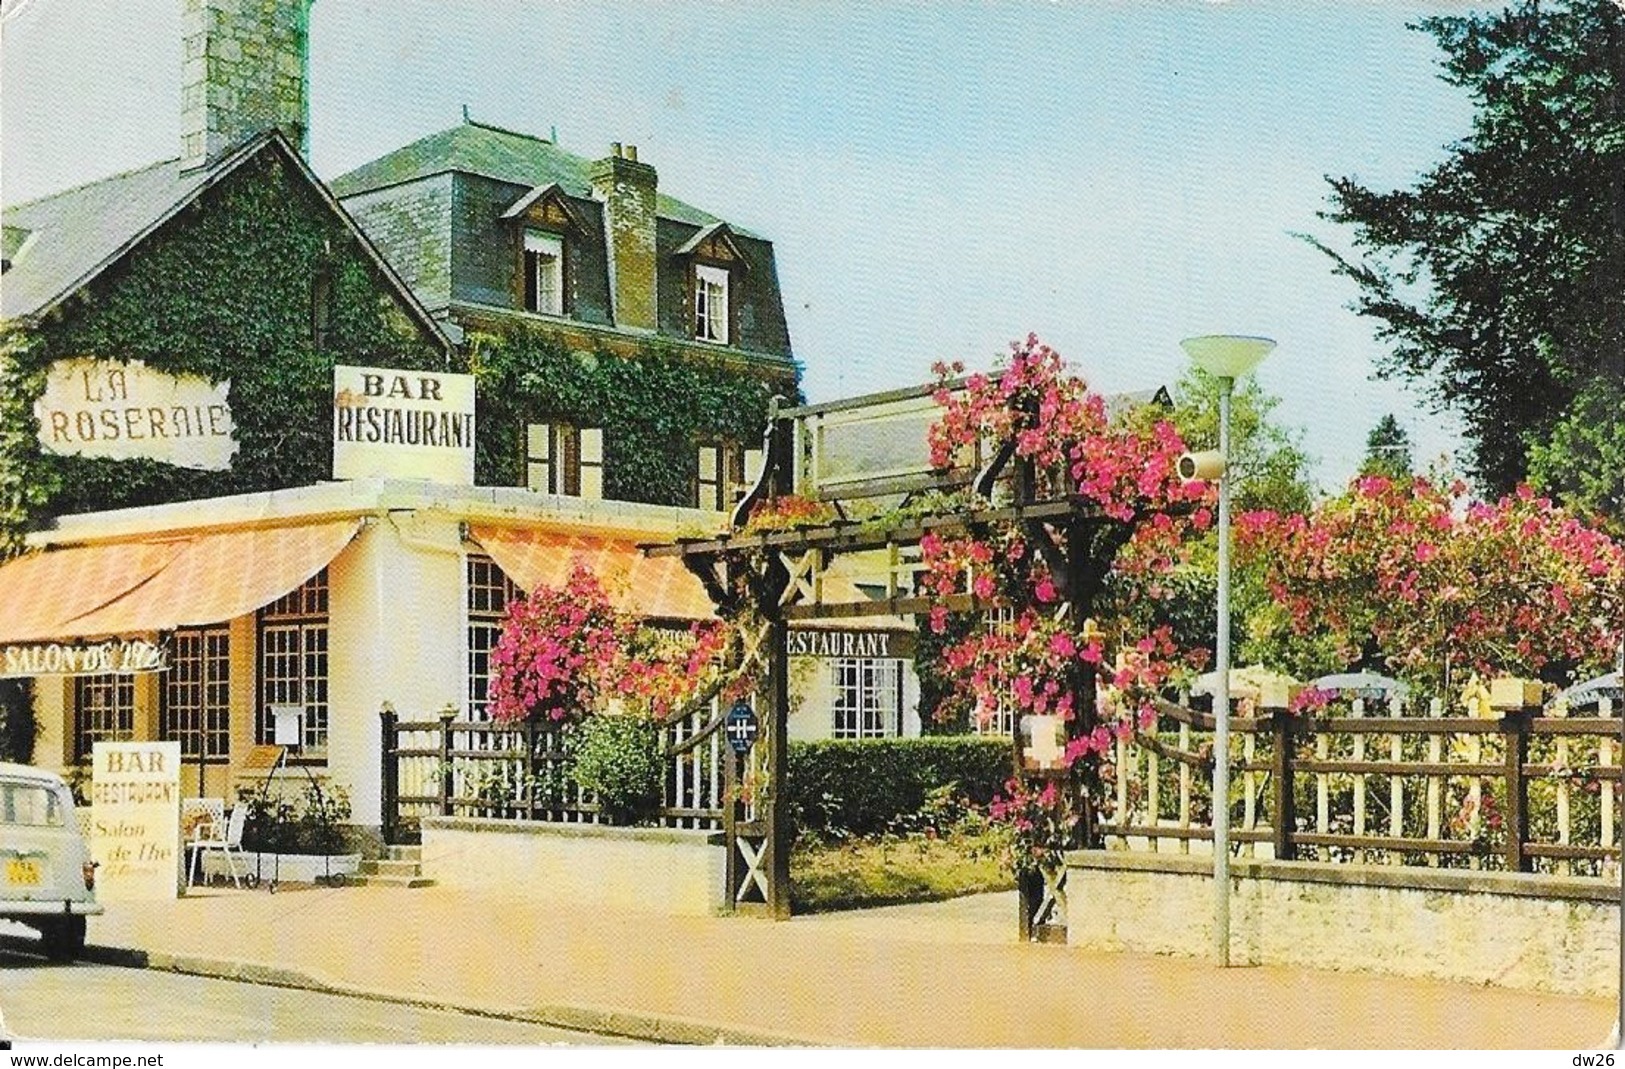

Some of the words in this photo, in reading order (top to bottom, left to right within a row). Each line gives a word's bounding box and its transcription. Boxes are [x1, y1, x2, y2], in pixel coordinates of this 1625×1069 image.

[83, 369, 127, 402] LA
[361, 373, 443, 401] BAR
[50, 405, 227, 443] ROSERAIE
[338, 406, 473, 447] RESTAURANT
[787, 631, 889, 656] ESTAURANT
[6, 644, 80, 673] SALON
[83, 642, 113, 669] DE
[106, 752, 164, 773] BAR
[94, 781, 177, 803] RESTAURANT
[96, 820, 146, 837] Salon
[108, 846, 131, 861] de
